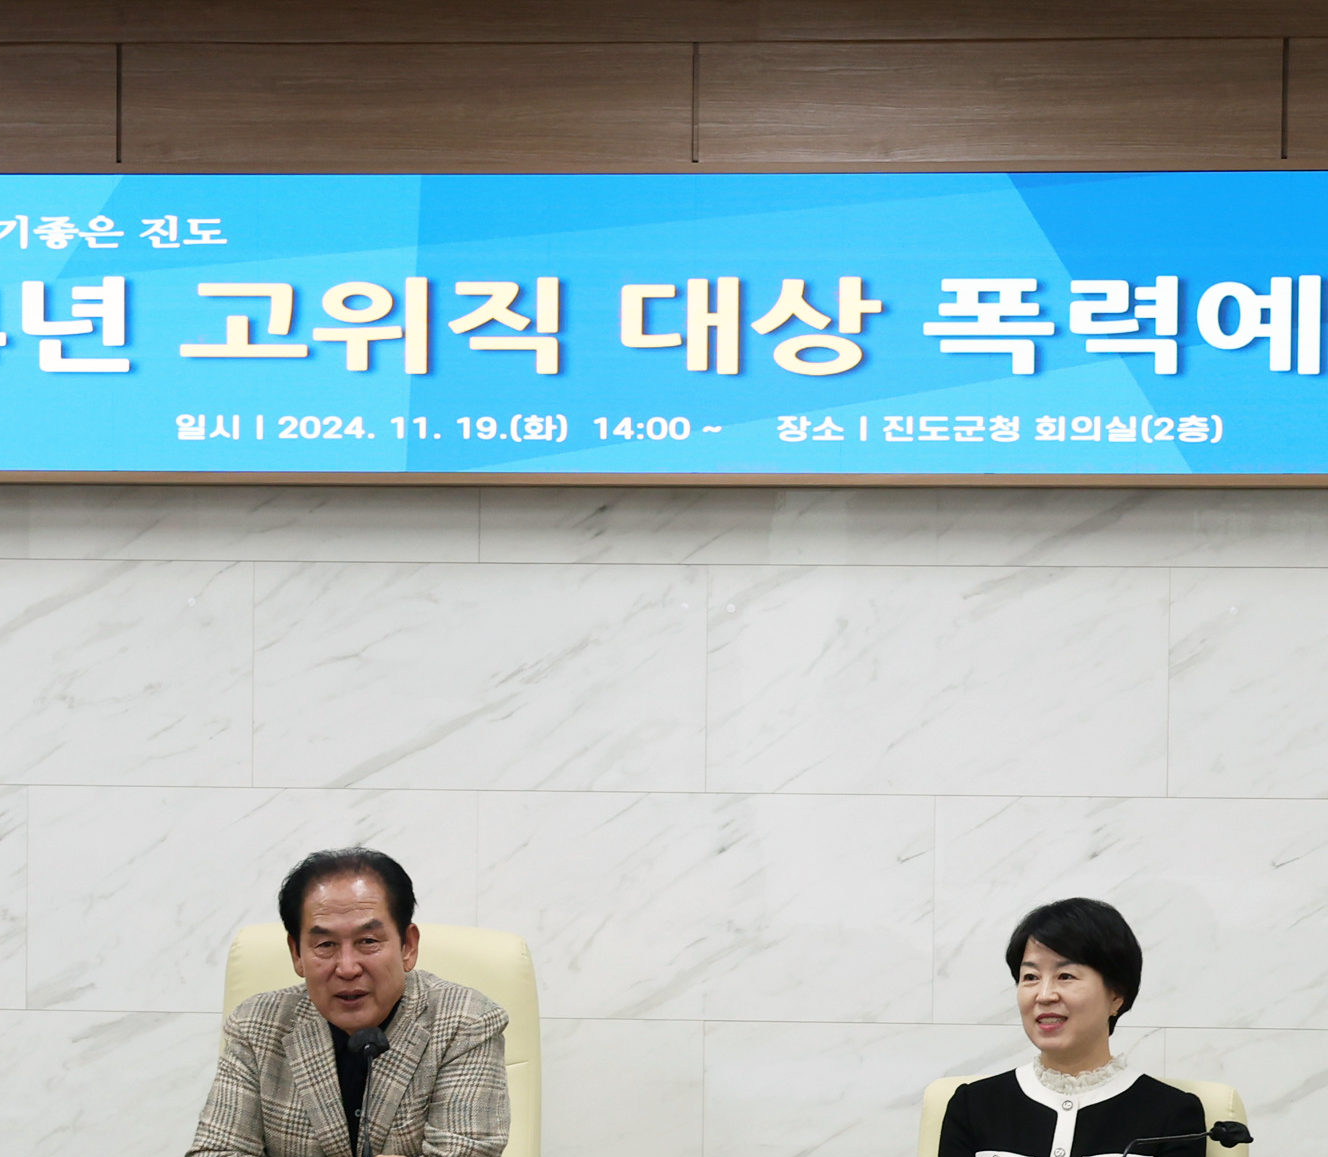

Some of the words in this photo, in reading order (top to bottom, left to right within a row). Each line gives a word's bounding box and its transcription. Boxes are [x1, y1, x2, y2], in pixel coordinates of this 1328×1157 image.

[138, 213, 229, 250] 진도
[178, 275, 560, 376] 고위직
[619, 275, 883, 377] 대상
[174, 413, 241, 442] 일시
[277, 414, 376, 440] 2024.
[389, 415, 442, 440] 11.
[455, 413, 569, 444] 19.(화)
[592, 415, 692, 442] 14:00
[776, 414, 846, 443] 장소
[881, 414, 1021, 444] 진도군청
[1033, 413, 1224, 445] 회의실(2층)
